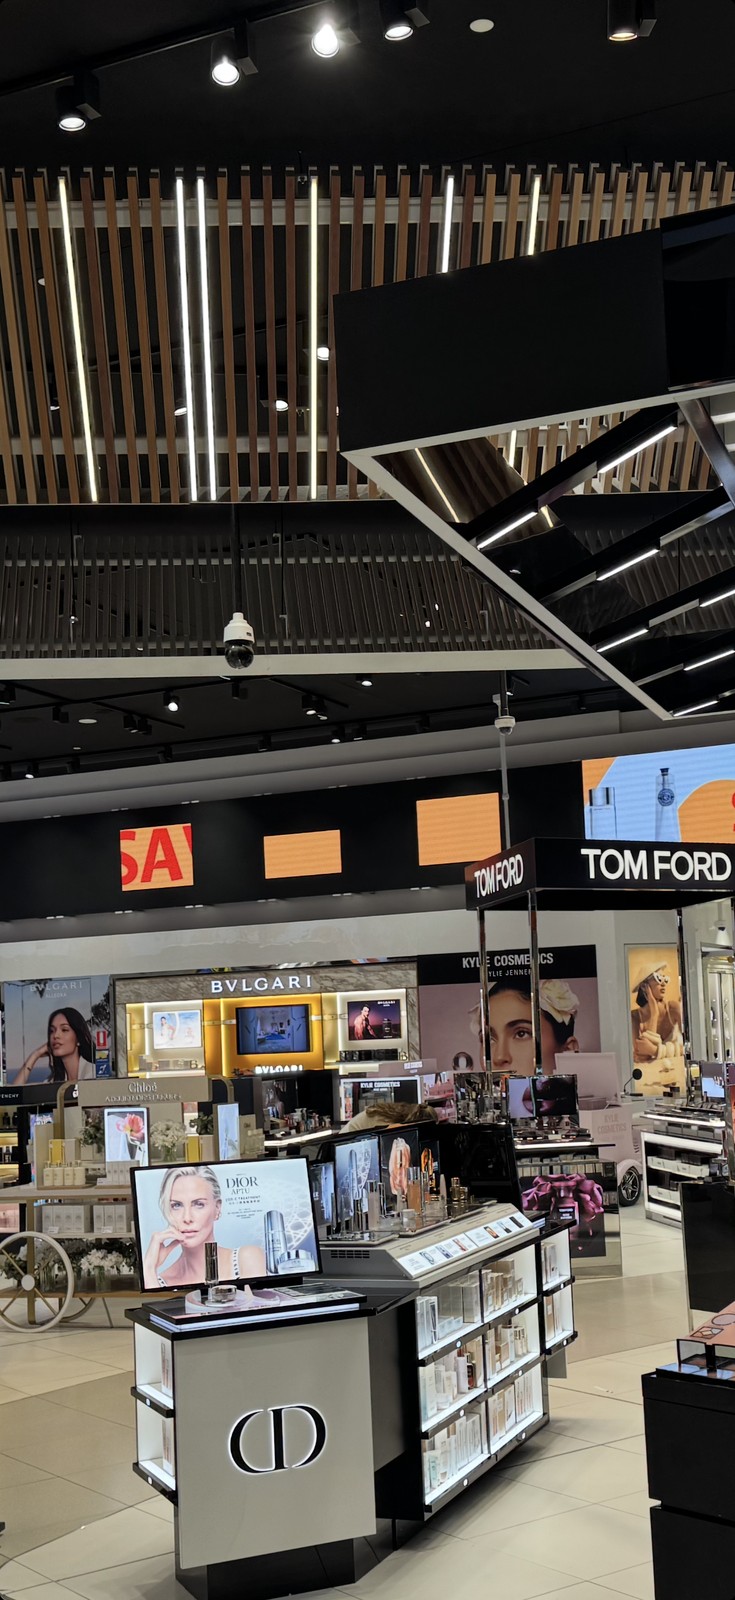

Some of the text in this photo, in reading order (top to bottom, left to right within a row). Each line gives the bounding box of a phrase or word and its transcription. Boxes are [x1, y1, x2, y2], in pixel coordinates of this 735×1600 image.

[120, 825, 192, 886] SA
[580, 848, 732, 881] TOM FORD
[474, 853, 524, 898] TOM FORD
[462, 956, 491, 968] KYLE
[30, 981, 82, 992] BVLGARI
[211, 974, 312, 993] BVLGARI
[128, 1081, 158, 1093] Chloé
[226, 1176, 259, 1188] DIOR
